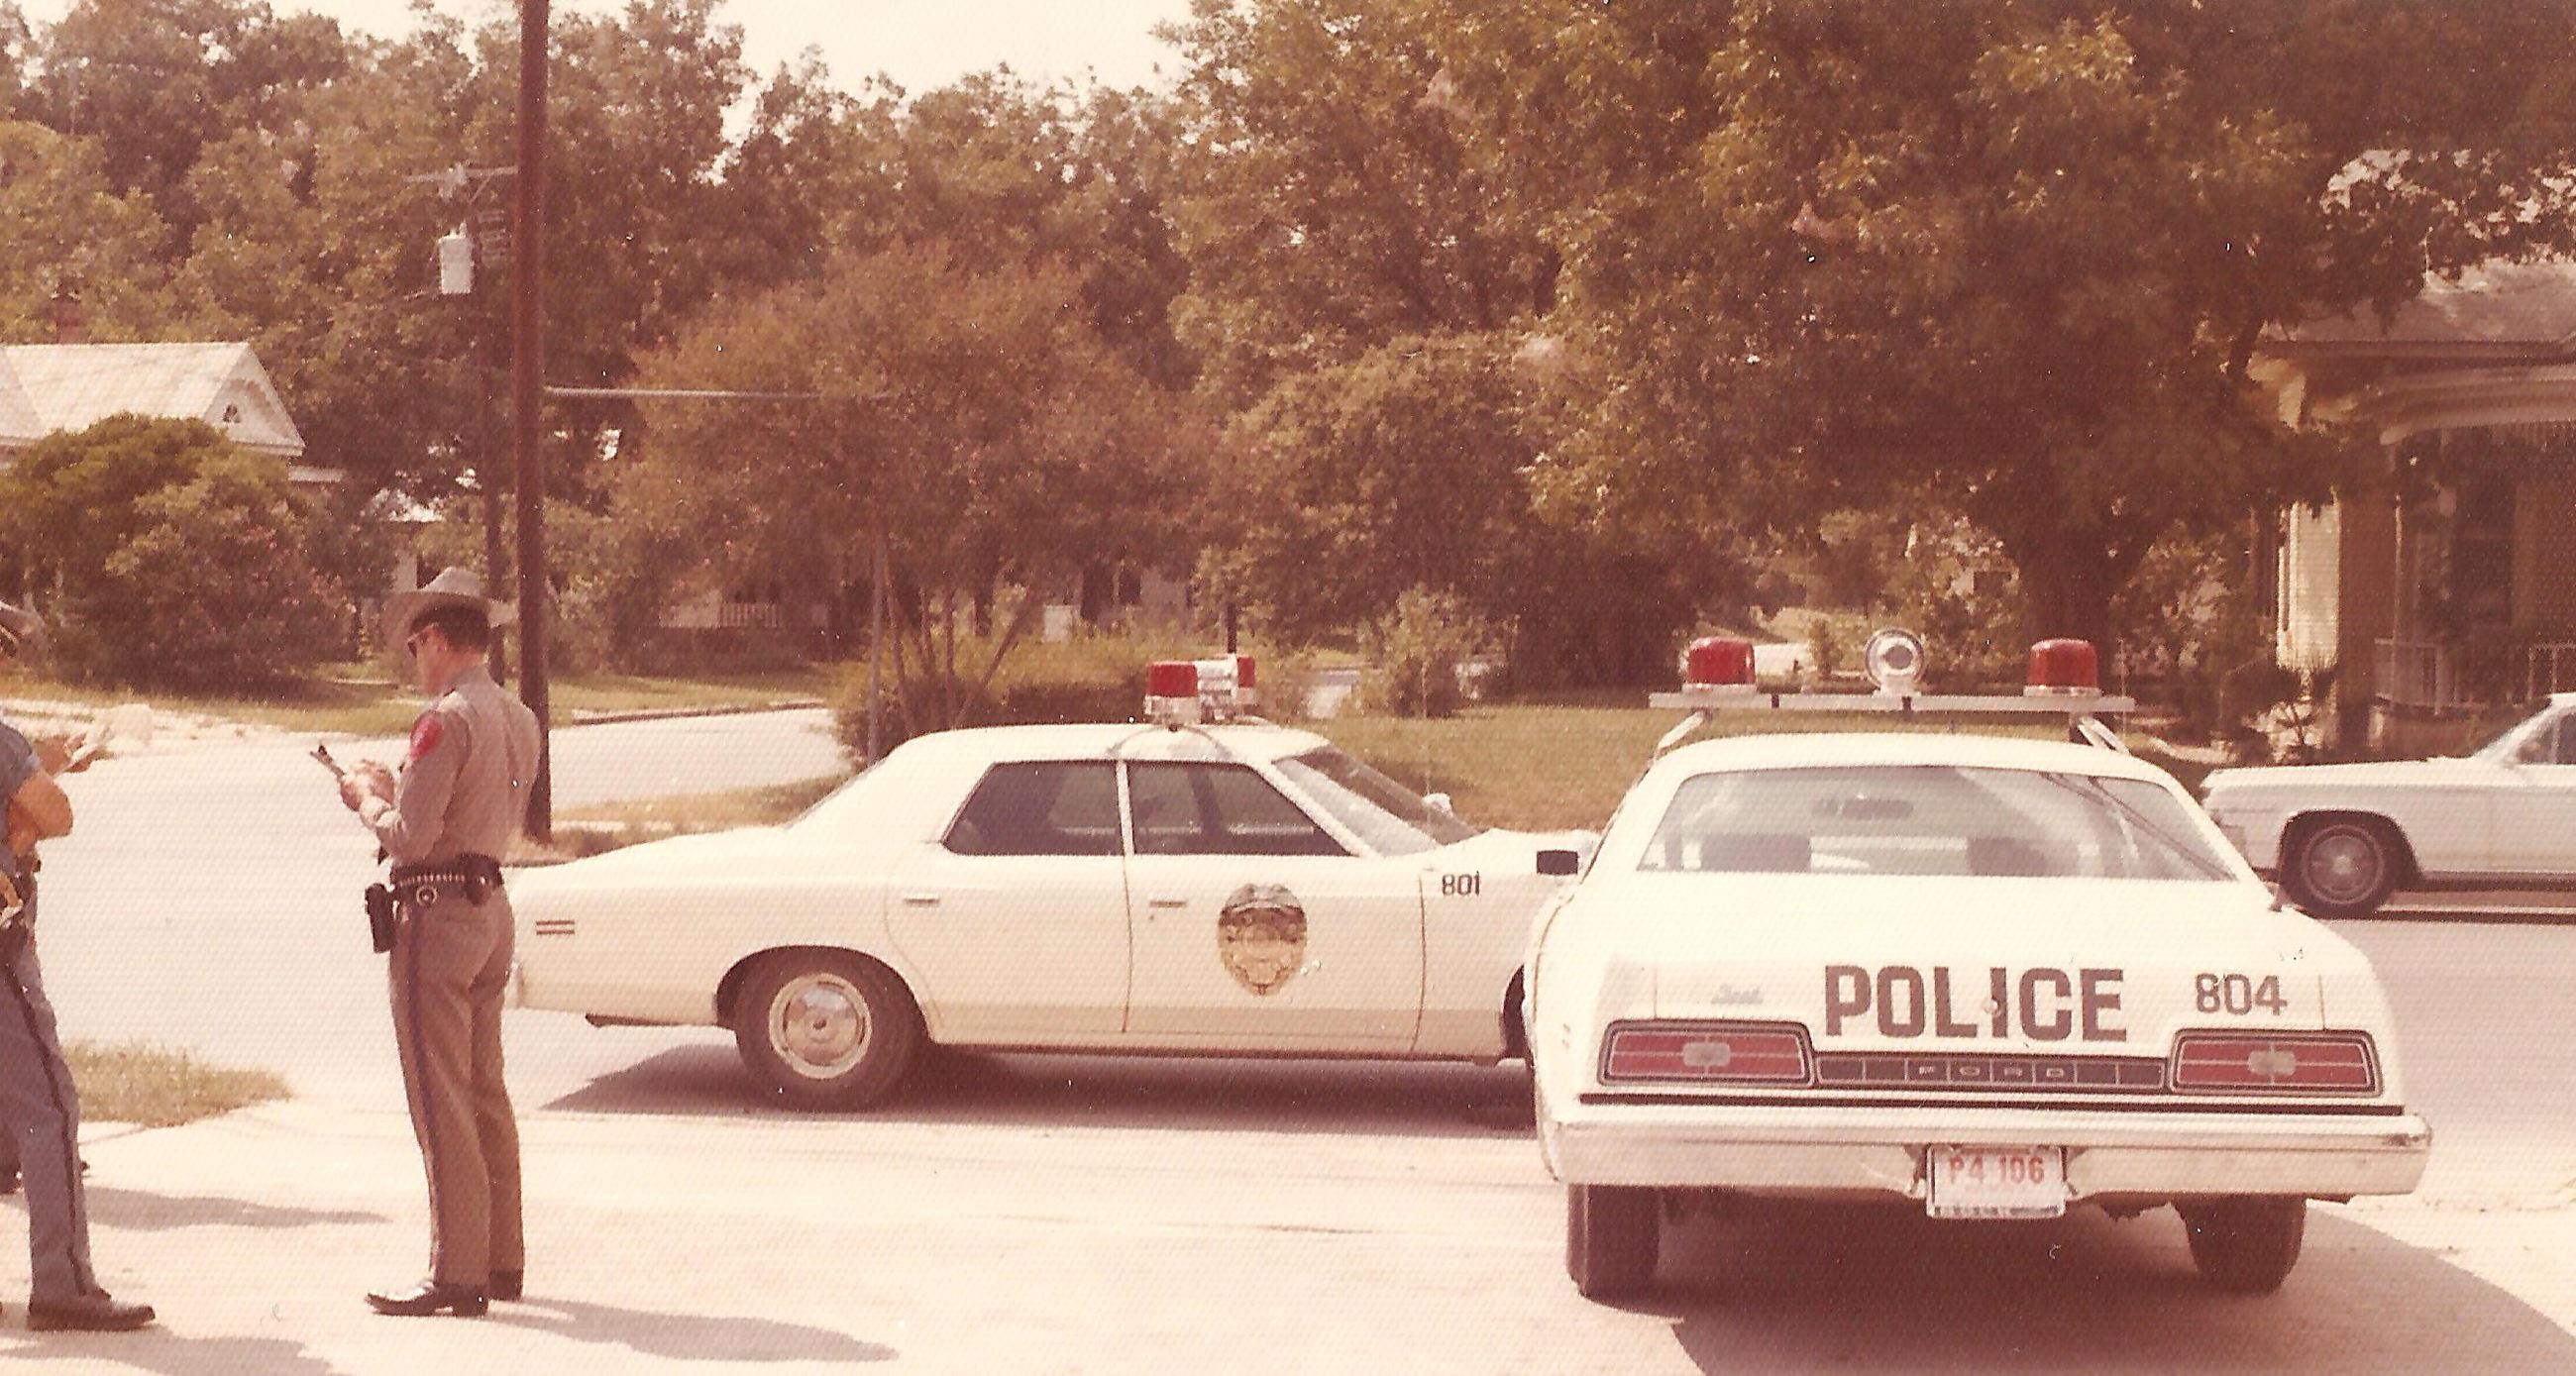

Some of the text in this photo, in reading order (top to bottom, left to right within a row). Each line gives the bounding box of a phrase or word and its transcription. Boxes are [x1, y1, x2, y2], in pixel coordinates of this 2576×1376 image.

[1442, 871, 1480, 897] 801
[1824, 965, 2127, 1042] POLICE
[2195, 973, 2288, 1016] 804
[1918, 1065, 2065, 1079] FORD
[1949, 1154, 2045, 1185] P4 106
